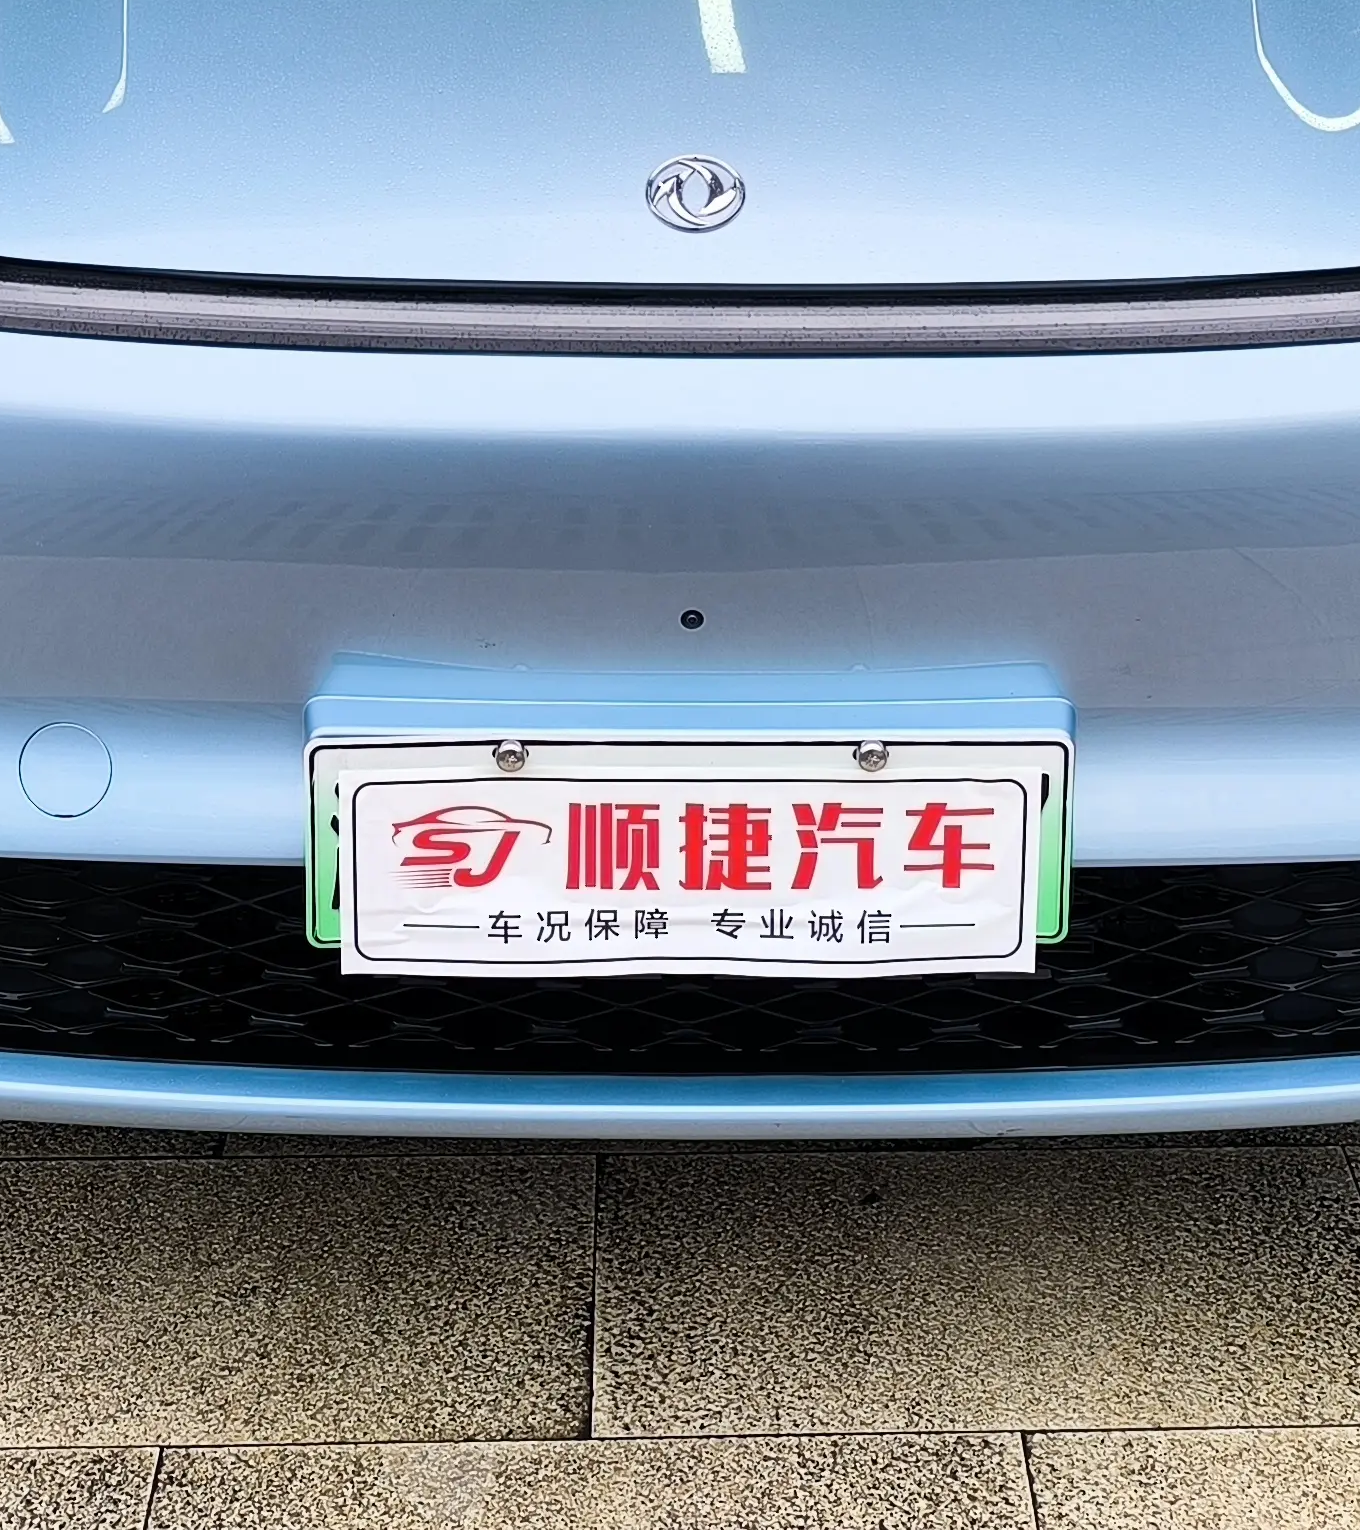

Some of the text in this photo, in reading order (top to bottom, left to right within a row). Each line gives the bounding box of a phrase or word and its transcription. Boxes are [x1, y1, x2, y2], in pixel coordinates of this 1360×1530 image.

[565, 801, 995, 891] 顺捷汽车
[487, 908, 894, 945] 车况保障 专业诚信
